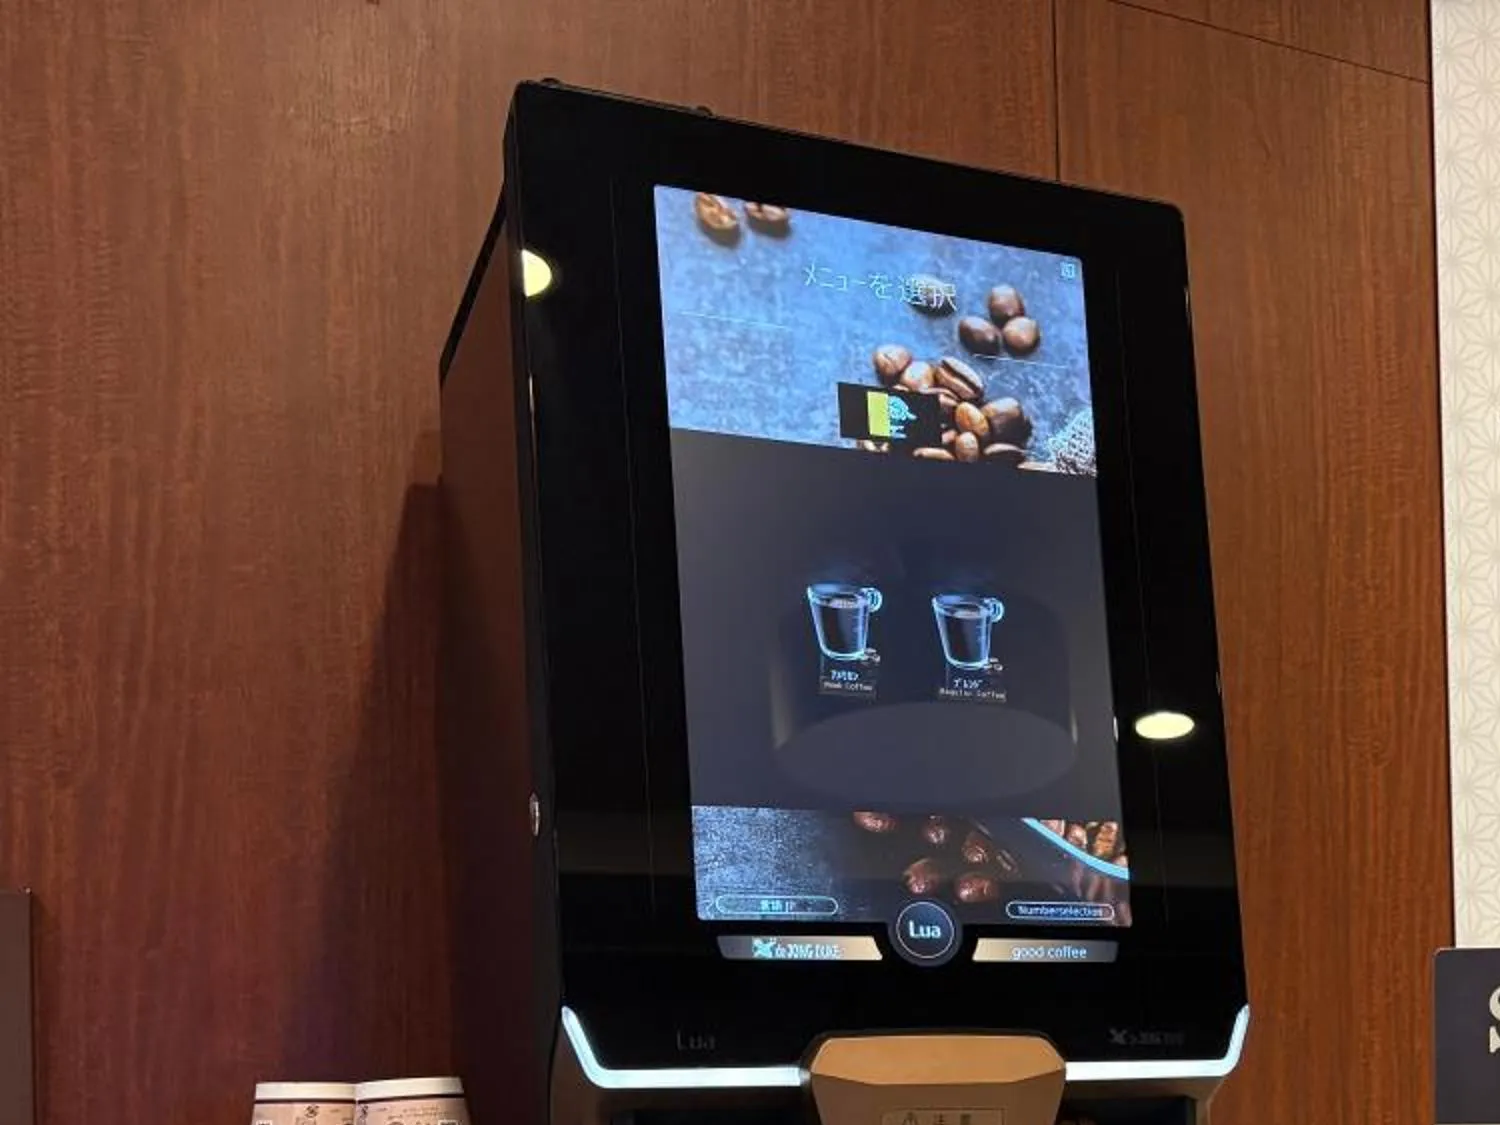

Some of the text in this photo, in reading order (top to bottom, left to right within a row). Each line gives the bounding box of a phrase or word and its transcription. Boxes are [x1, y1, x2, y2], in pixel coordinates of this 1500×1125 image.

[803, 257, 958, 312] メニューを選択
[908, 919, 942, 939] Lua
[1011, 944, 1088, 959] good coffee
